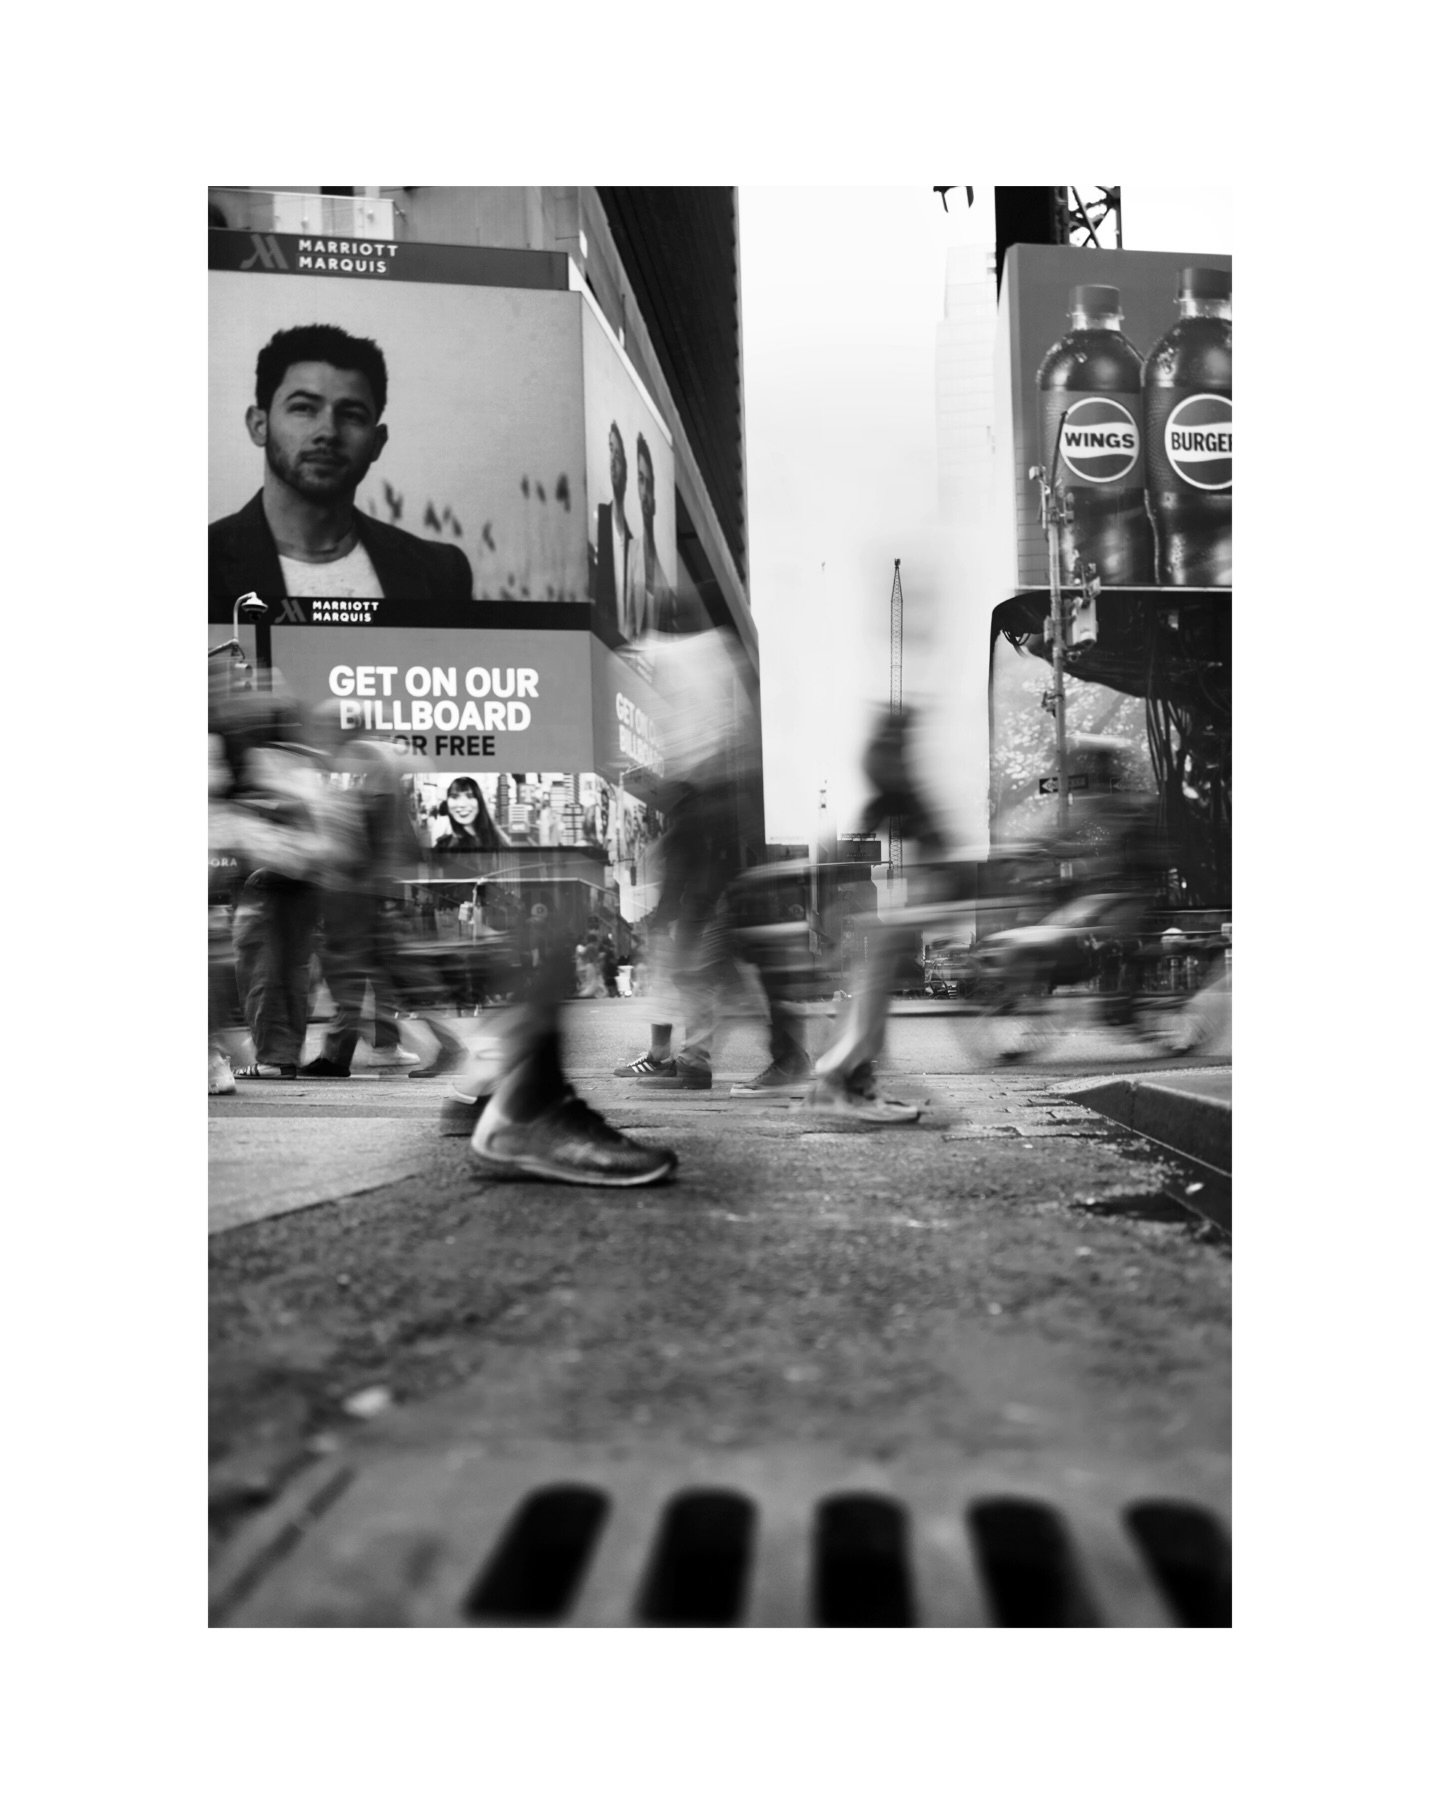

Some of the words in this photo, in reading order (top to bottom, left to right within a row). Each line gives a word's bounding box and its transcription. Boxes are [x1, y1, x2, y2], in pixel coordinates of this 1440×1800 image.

[299, 239, 399, 257] MARRIOTT
[299, 256, 387, 273] MARQUIS
[1065, 432, 1135, 449] WINGS
[312, 600, 379, 611] MARRIOTT
[312, 611, 372, 622] MARQUIS
[328, 665, 398, 697] GET
[405, 666, 457, 697] ON
[465, 667, 540, 698] OUR
[340, 700, 532, 731] BILLBOARD
[378, 735, 428, 756] OR
[435, 735, 495, 756] FREE
